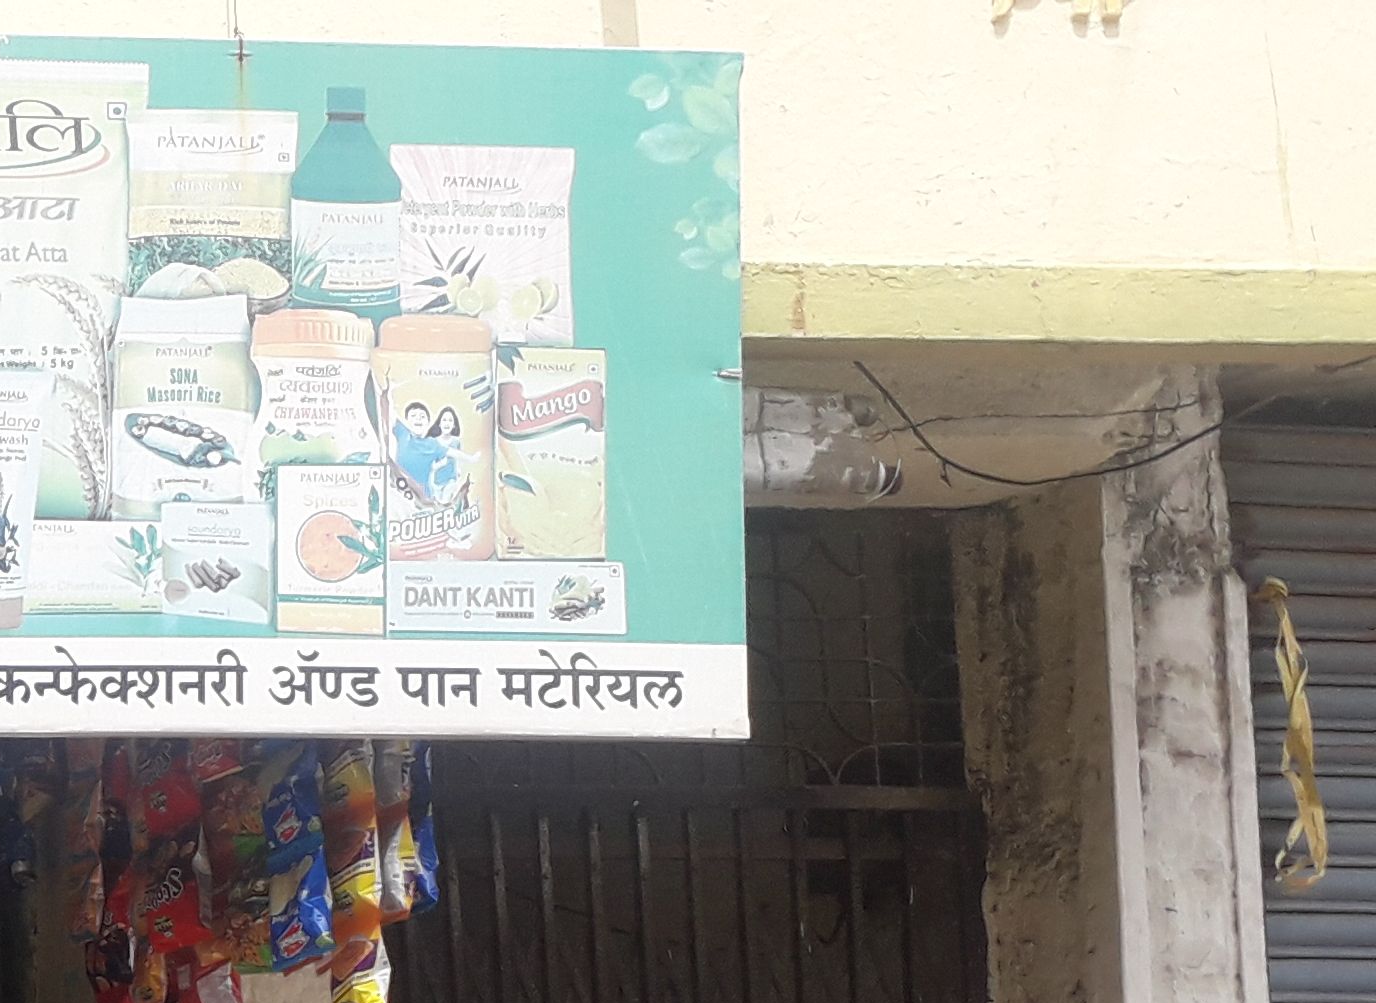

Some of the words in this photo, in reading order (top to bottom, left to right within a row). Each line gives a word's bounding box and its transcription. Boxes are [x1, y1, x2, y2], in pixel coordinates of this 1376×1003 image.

[25, 241, 69, 263] Atta
[169, 368, 198, 385] SONA
[147, 386, 193, 403] Masoori
[196, 387, 221, 404] Rice
[512, 387, 591, 426] Mango
[0, 435, 29, 446] wash
[389, 509, 455, 542] POWER
[404, 586, 462, 608] DANT
[466, 586, 535, 609] KANTI
[400, 663, 480, 708] पान
[496, 648, 685, 711] मटेरियल
